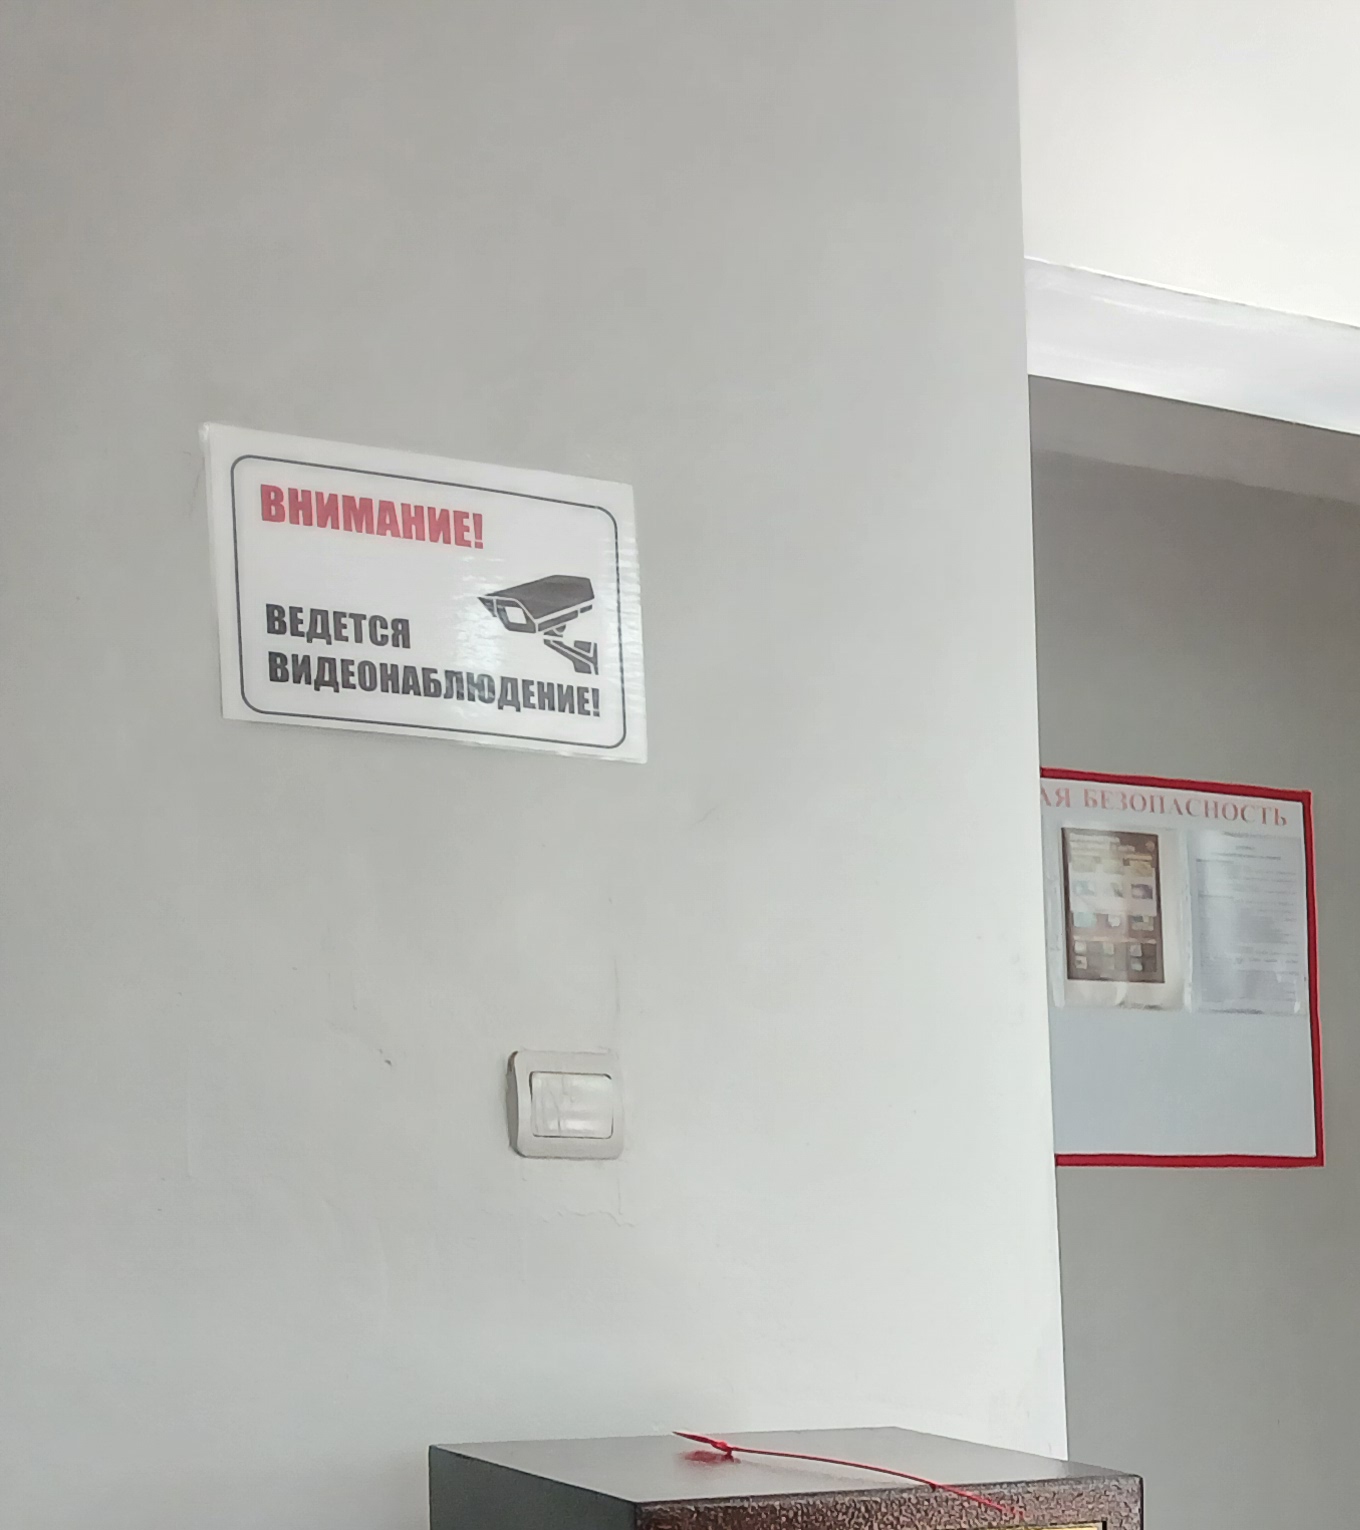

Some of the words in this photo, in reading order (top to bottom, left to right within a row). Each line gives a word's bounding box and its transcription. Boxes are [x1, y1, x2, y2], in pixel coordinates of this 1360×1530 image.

[259, 484, 484, 550] ВНИМАНИЕ!
[265, 603, 411, 650] ВЕДЕТСЯ
[268, 651, 601, 717] ВИДЕОНАБЛЮДЕНИЕ!
[1083, 787, 1288, 827] БЕЗОПАСНОСТЬ
